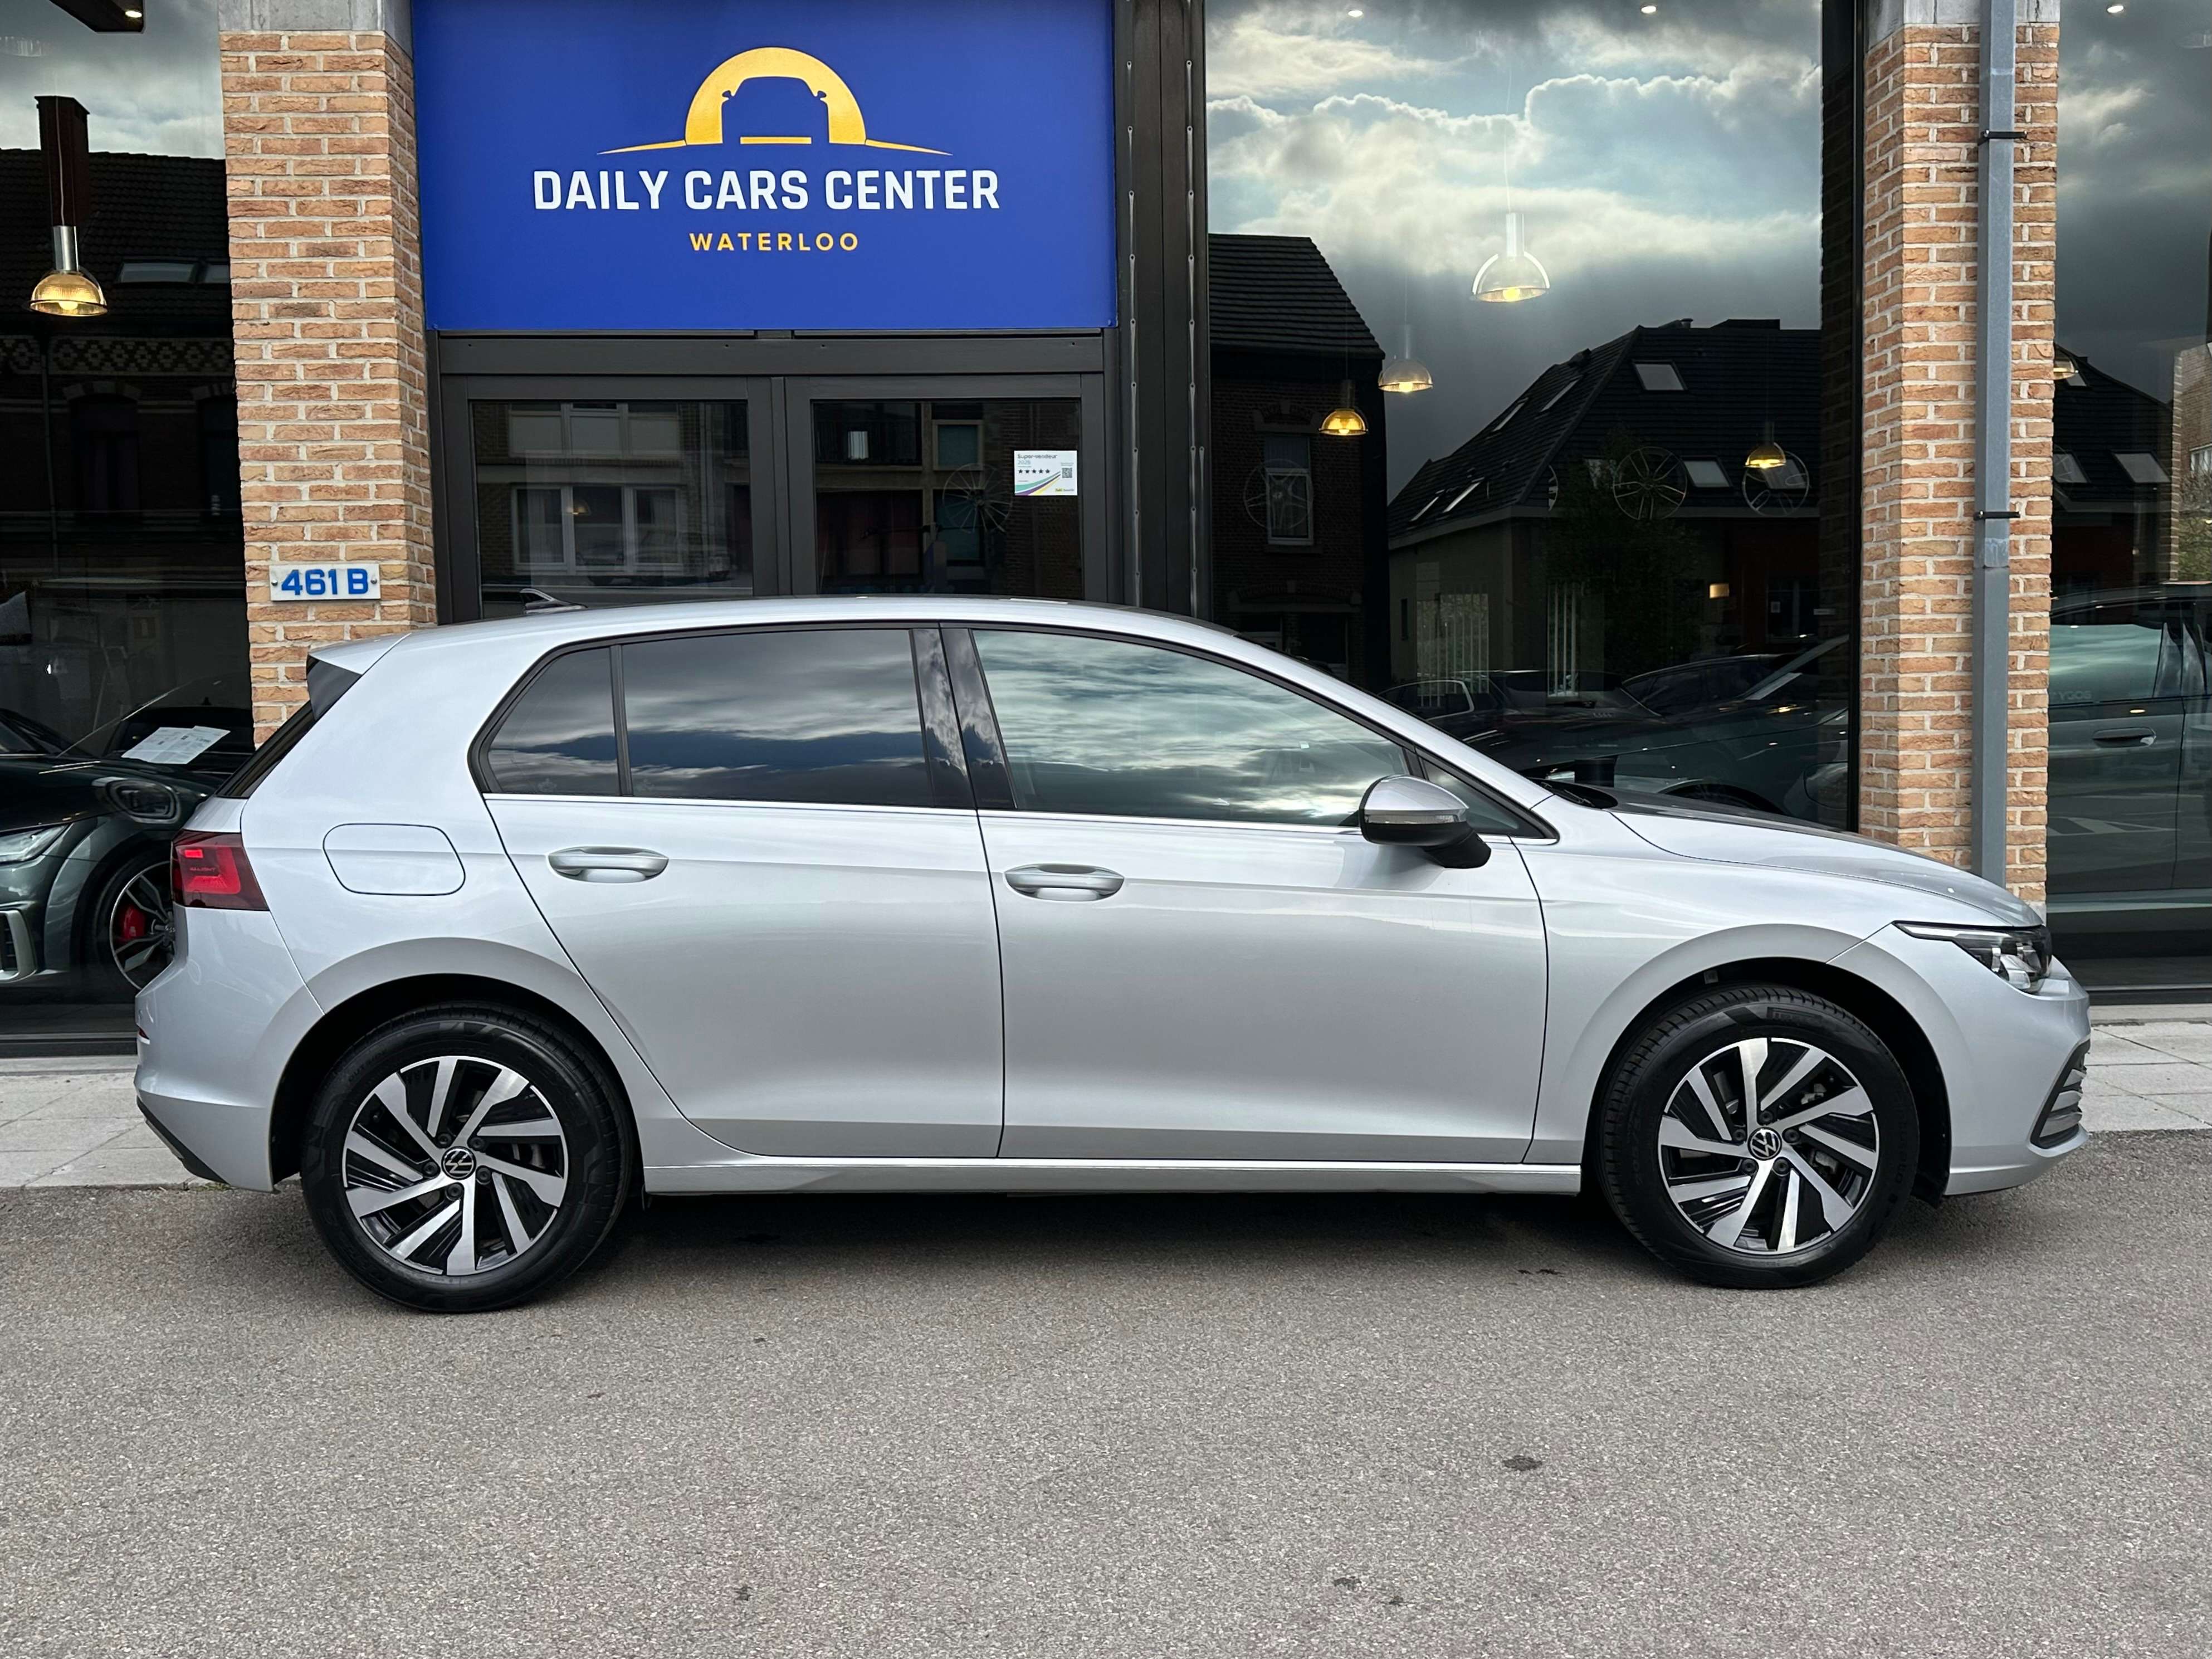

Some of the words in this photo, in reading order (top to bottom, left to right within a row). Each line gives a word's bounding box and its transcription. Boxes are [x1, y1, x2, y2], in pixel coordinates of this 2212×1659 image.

[533, 169, 669, 211] DAILY
[684, 169, 809, 211] CARS
[825, 169, 1000, 210] CENTER
[689, 232, 858, 252] WATERLOO
[281, 569, 338, 596] 461
[346, 568, 369, 595] B
